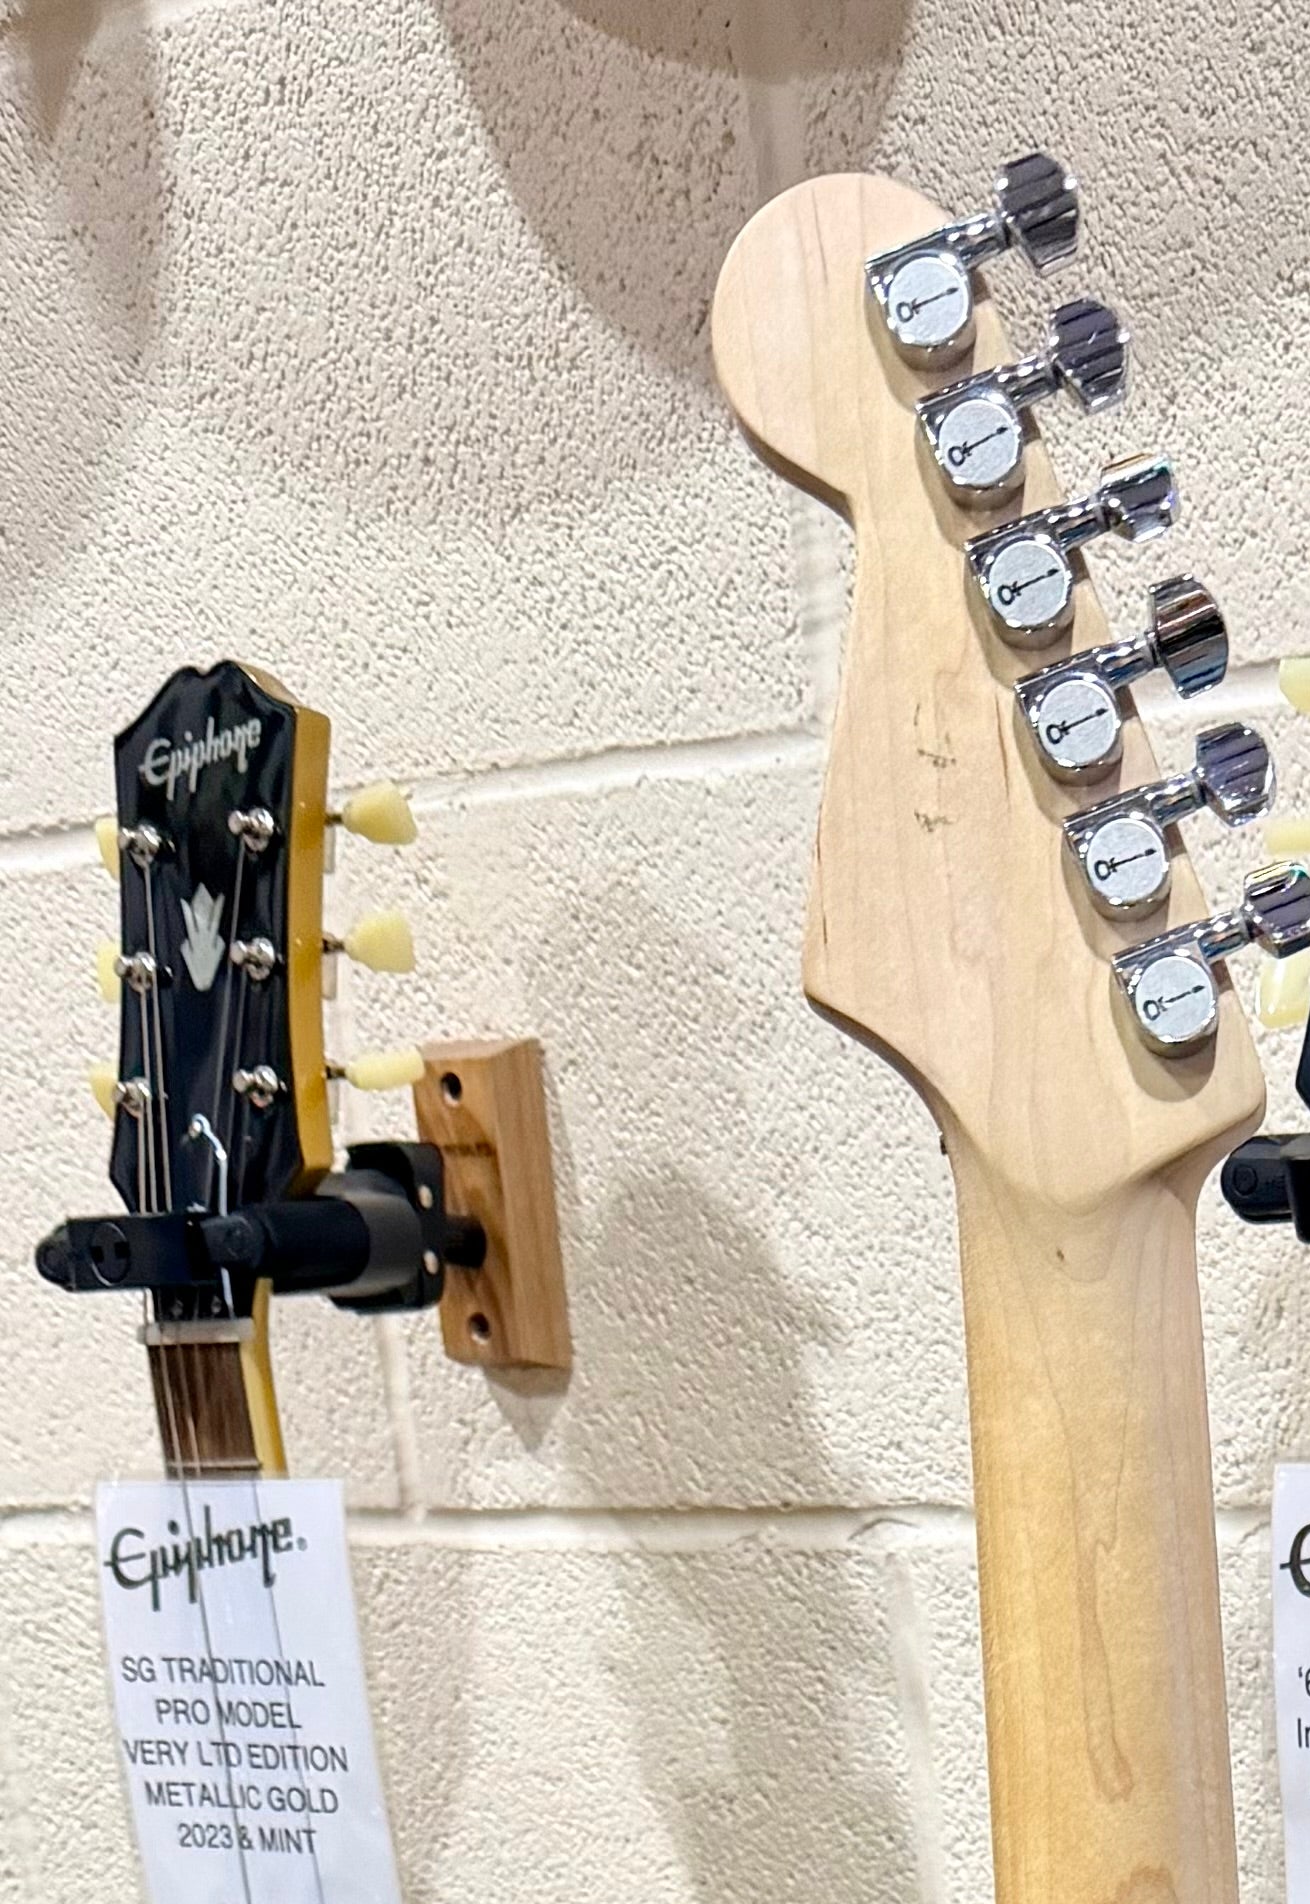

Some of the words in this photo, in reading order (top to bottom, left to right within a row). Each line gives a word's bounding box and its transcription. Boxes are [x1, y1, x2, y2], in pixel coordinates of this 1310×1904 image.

[138, 716, 262, 801] Epiphone
[121, 1656, 157, 1683] SG
[161, 1656, 326, 1687] TRADITIONAL
[155, 1698, 211, 1726] PRO
[215, 1701, 303, 1729] MODEL
[122, 1739, 189, 1767] VERY
[196, 1741, 243, 1768] LTD
[249, 1744, 350, 1772] EDITION
[144, 1781, 262, 1811] METALLIC
[267, 1786, 339, 1814] GOLD
[178, 1822, 234, 1849] 2023
[258, 1826, 317, 1855] MINT
